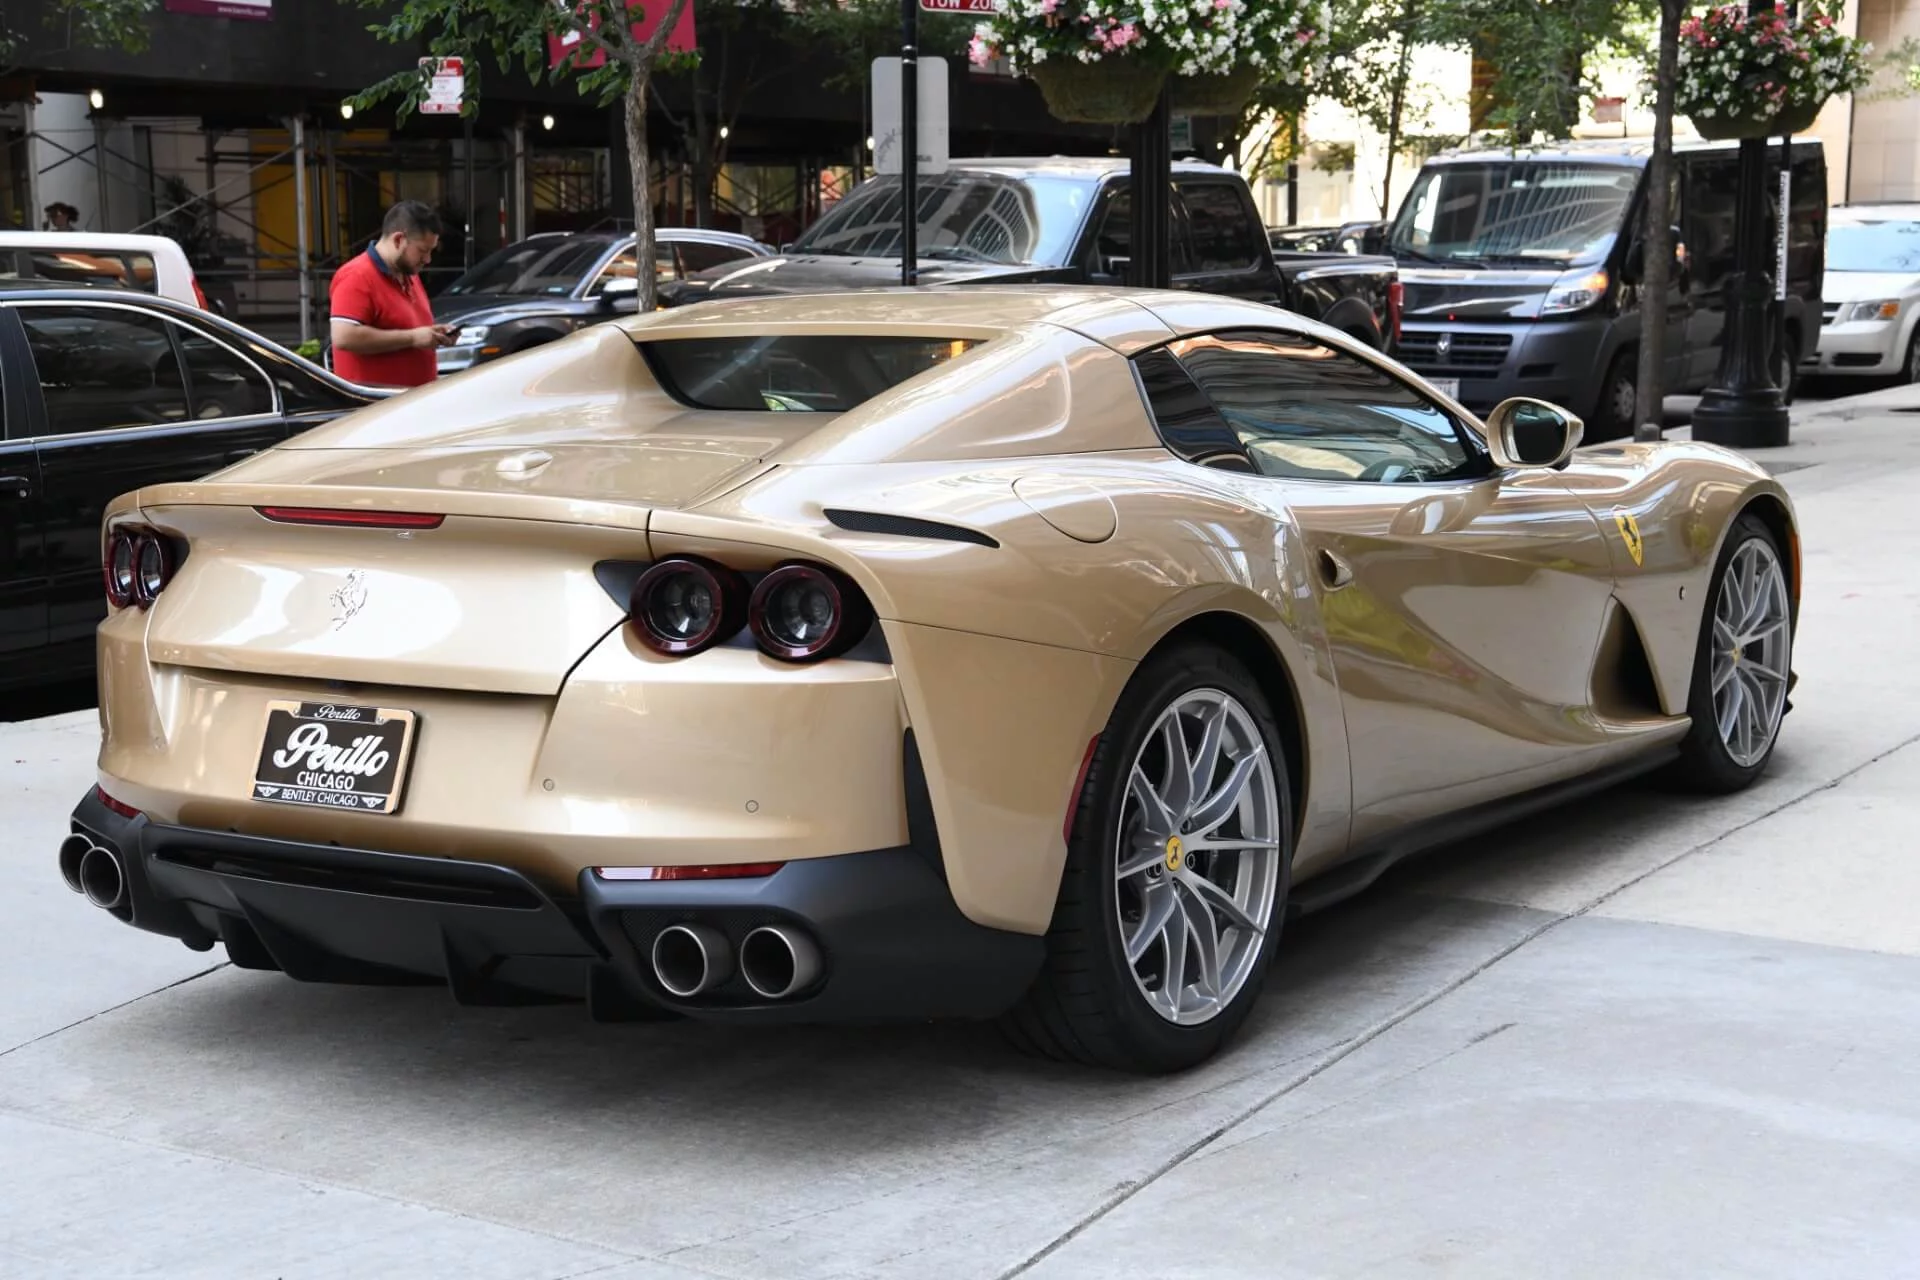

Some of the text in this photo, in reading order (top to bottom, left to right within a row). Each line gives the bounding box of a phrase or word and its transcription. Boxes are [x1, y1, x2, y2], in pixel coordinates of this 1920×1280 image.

[314, 705, 361, 720] Perillo
[273, 723, 389, 777] Perillo
[296, 771, 355, 790] CHICAGO
[281, 788, 359, 807] BENTLEY CHICAGO
